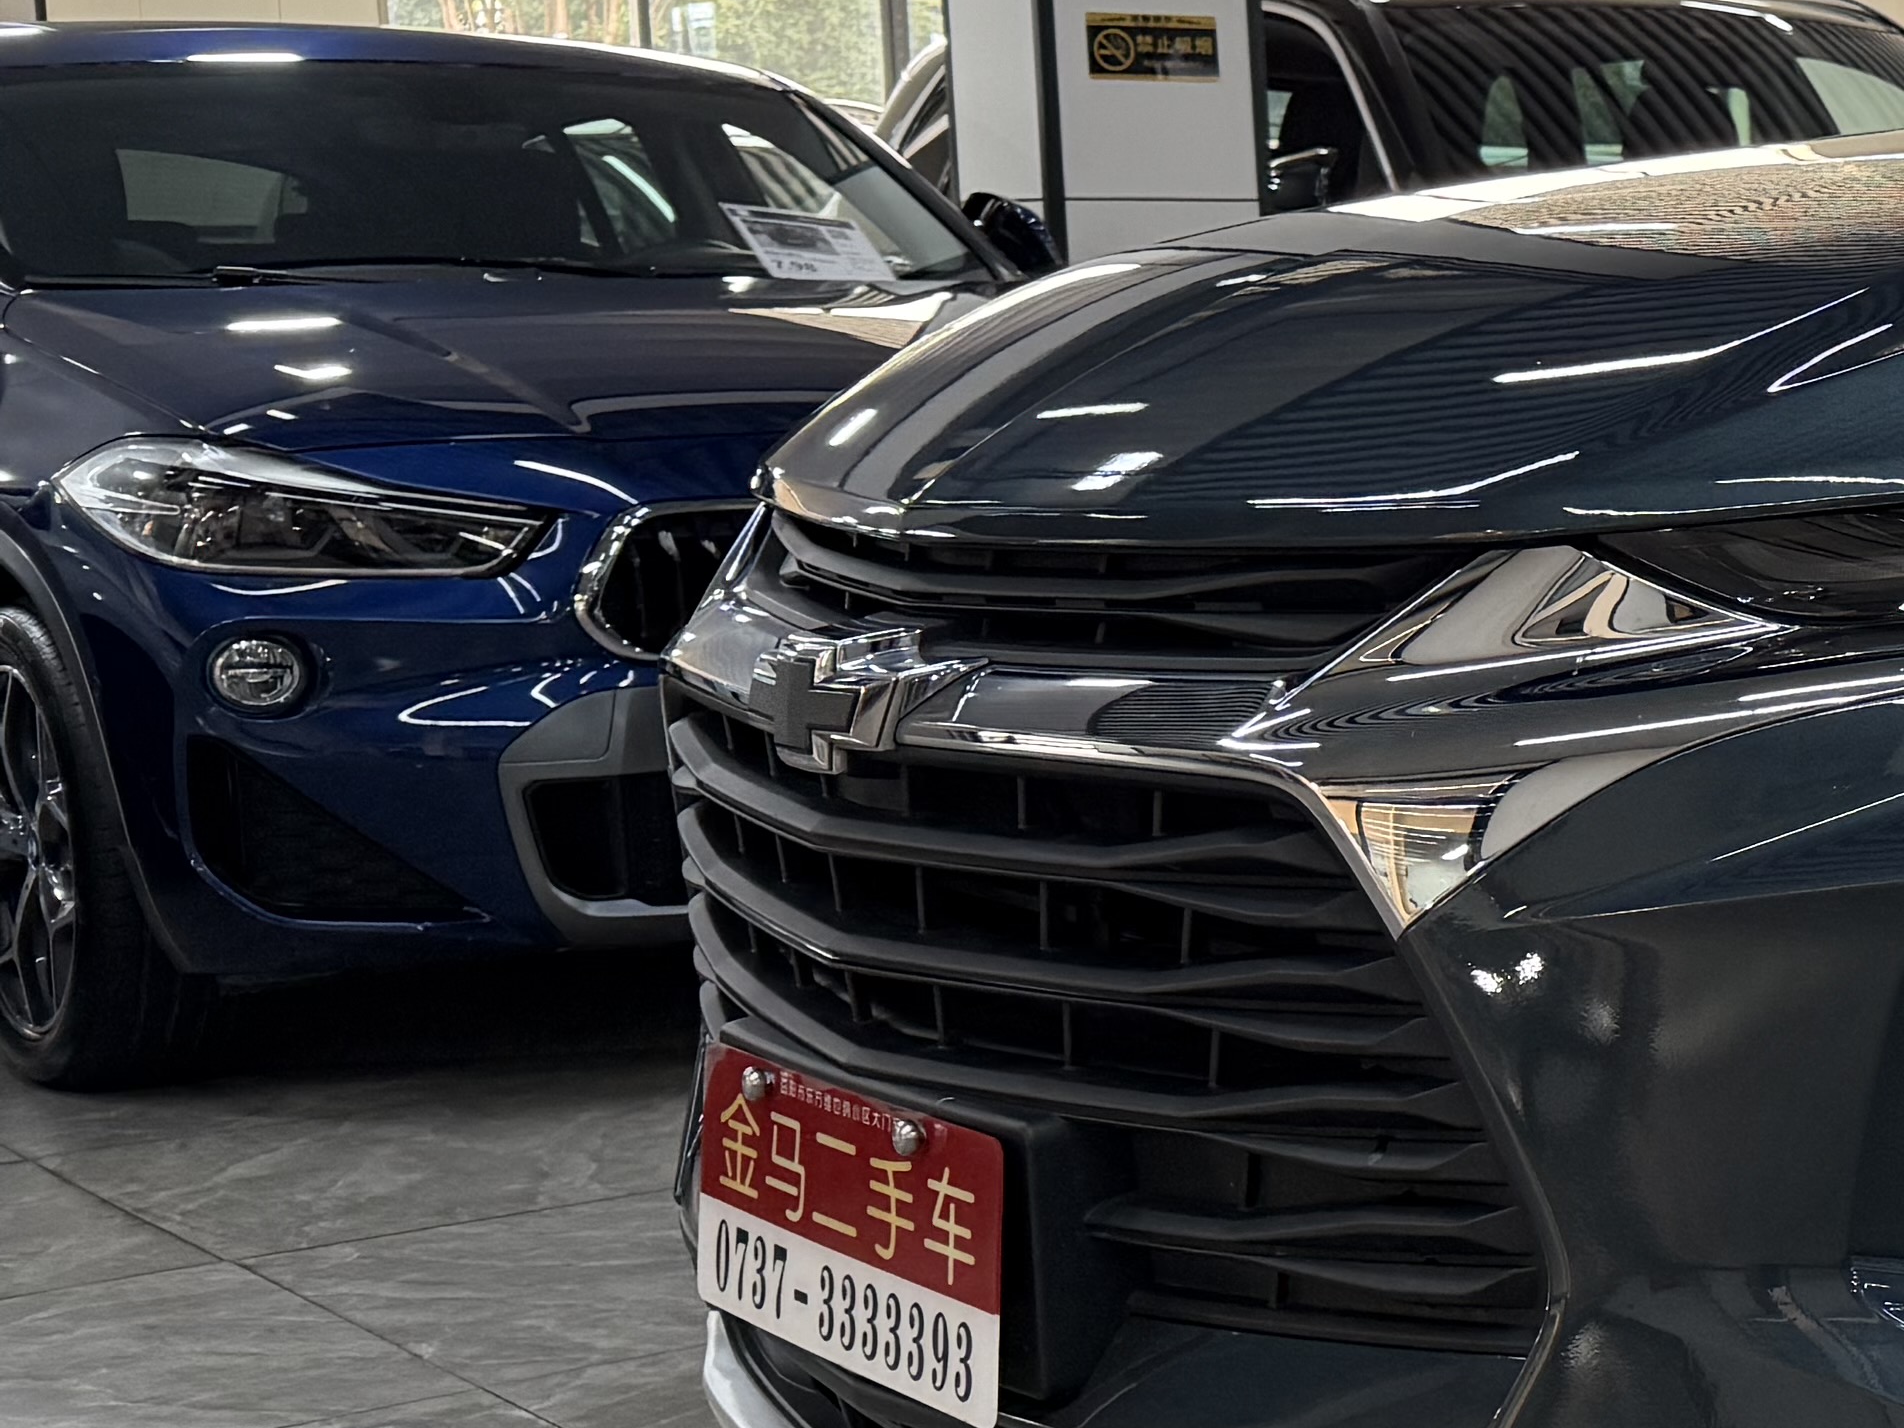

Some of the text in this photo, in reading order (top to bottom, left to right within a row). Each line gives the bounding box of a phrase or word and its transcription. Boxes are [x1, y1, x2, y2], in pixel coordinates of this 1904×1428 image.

[719, 1093, 976, 1286] 金马二手车
[716, 1219, 973, 1403] 0737-3333393
